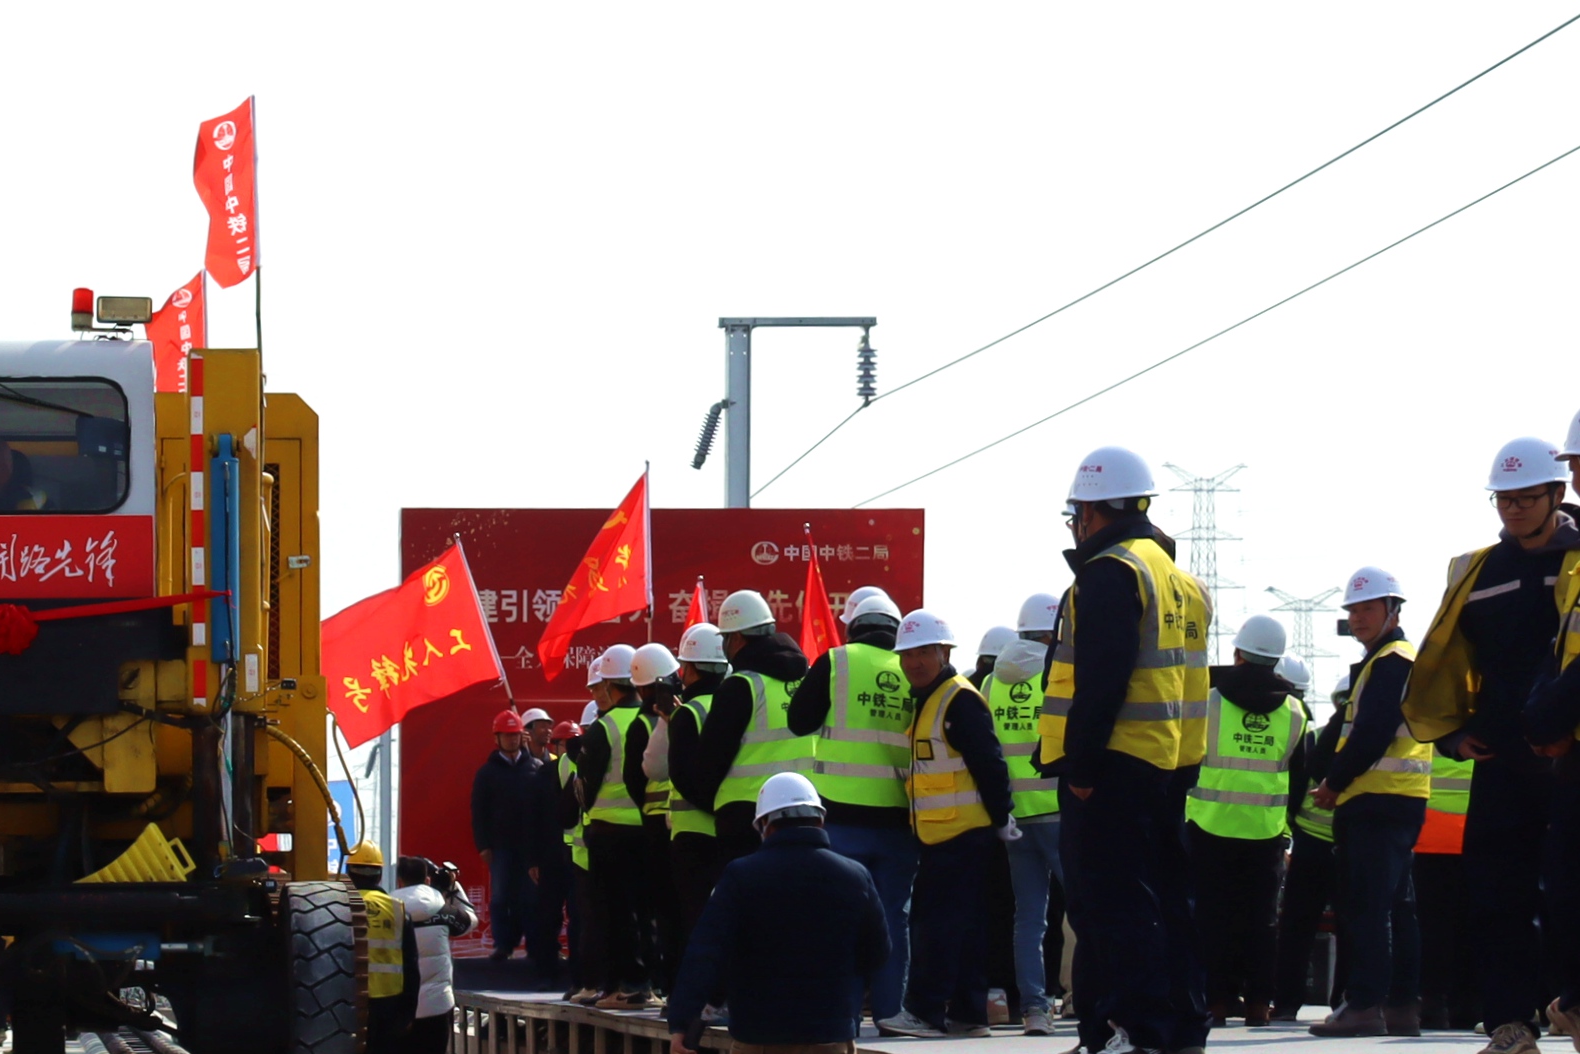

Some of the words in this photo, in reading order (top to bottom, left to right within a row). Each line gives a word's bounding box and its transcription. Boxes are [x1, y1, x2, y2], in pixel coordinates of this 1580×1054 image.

[223, 154, 251, 276] 中国中铁二局
[784, 544, 889, 562] 中国中铁二局
[857, 691, 916, 714] 中铁二局
[994, 706, 1042, 721] 中铁二局
